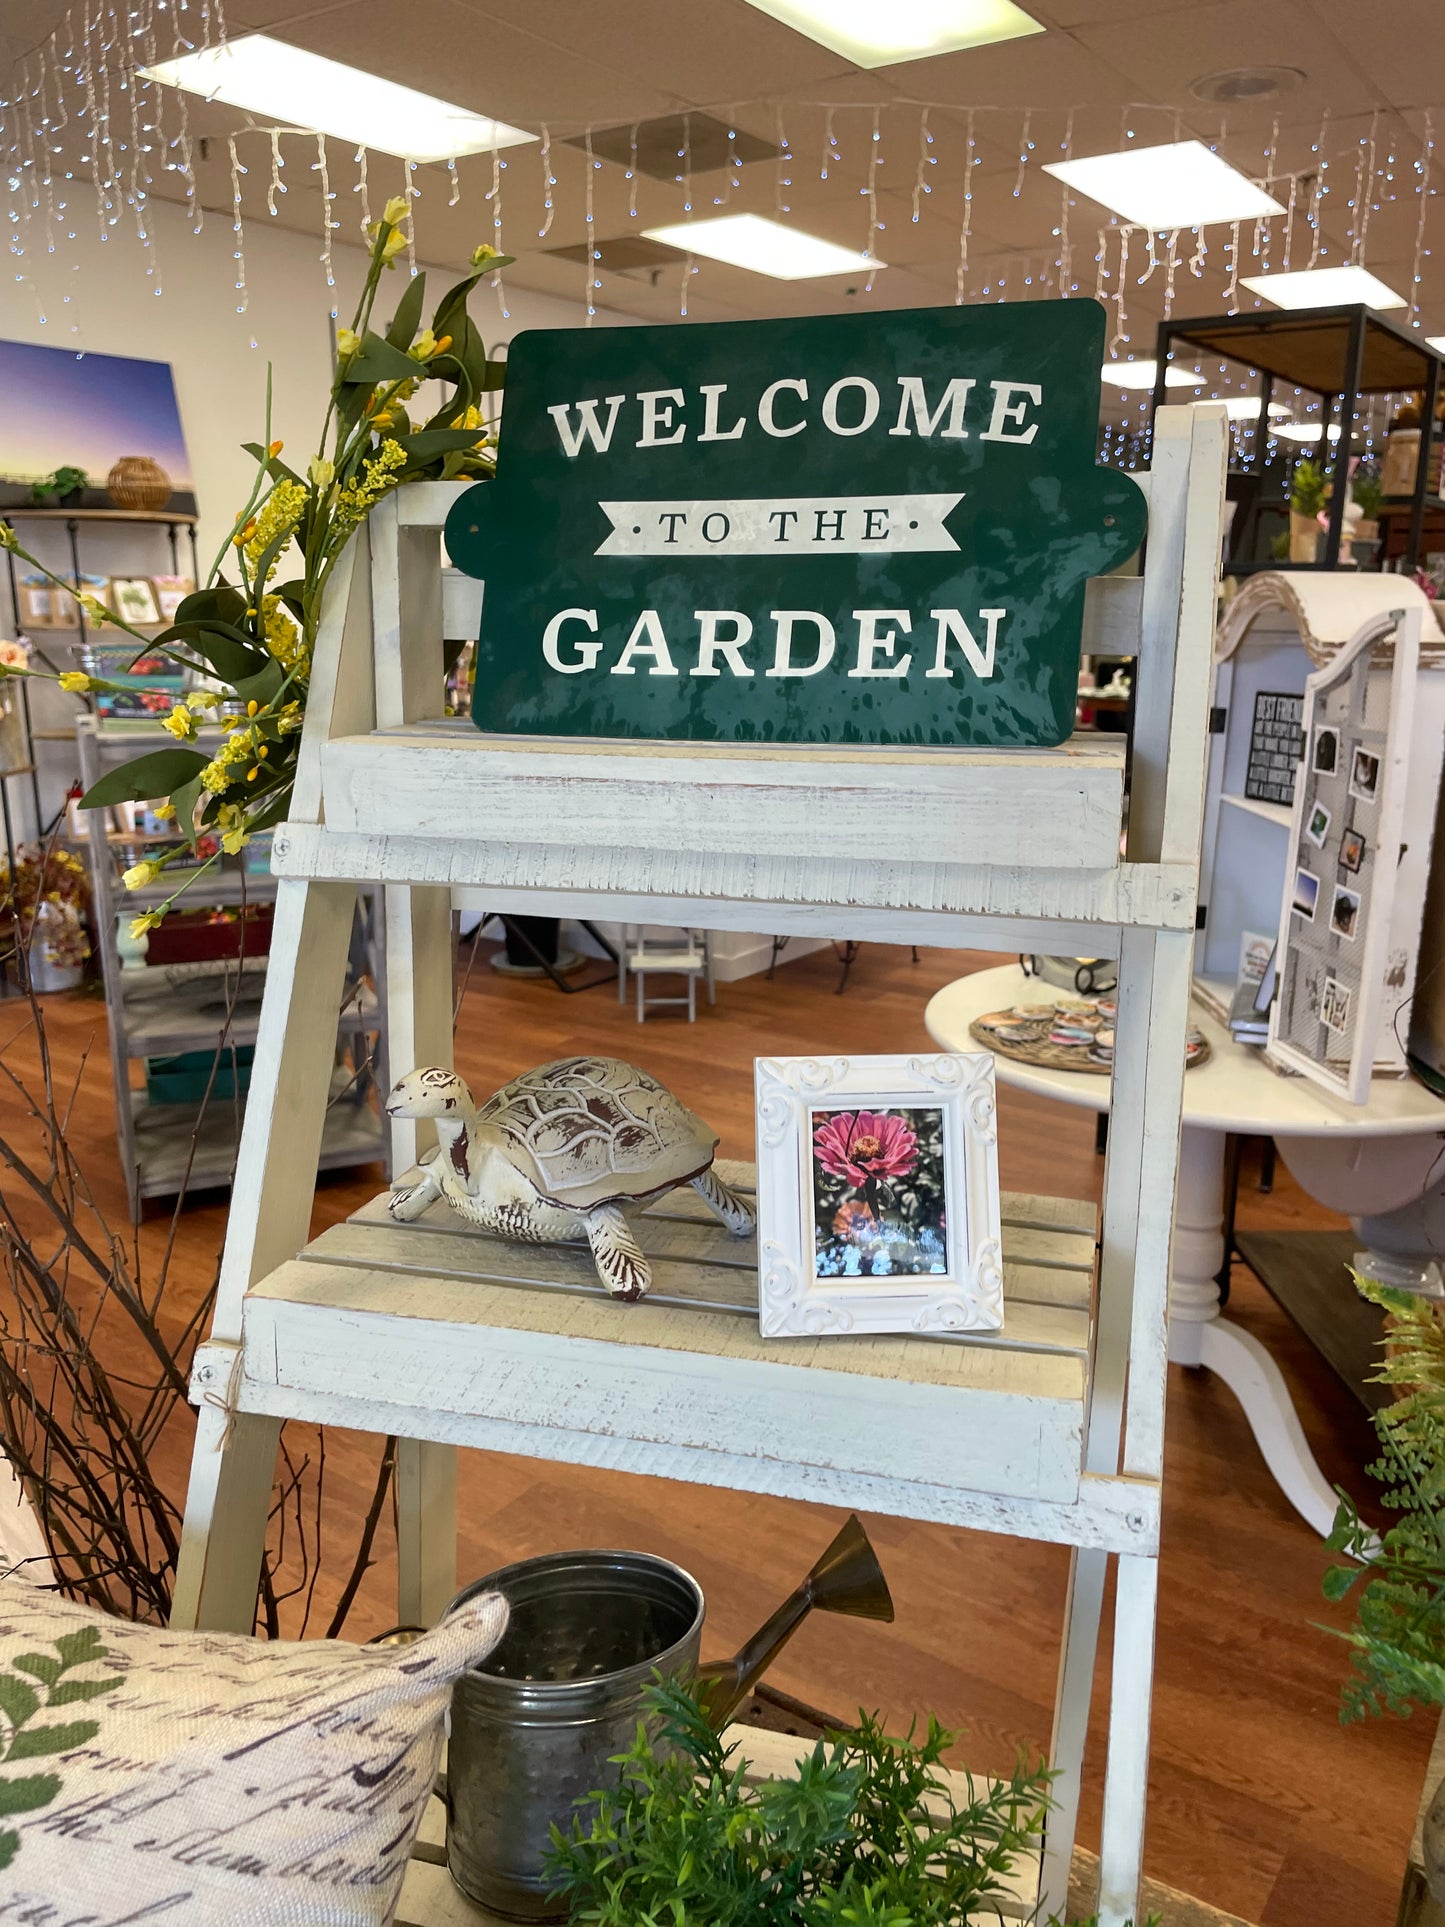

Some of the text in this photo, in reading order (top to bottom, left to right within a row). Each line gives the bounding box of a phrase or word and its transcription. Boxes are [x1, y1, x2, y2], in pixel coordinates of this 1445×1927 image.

[547, 376, 1042, 458] WELCOME
[658, 508, 891, 543] TO THE
[542, 608, 1007, 679] GARDEN
